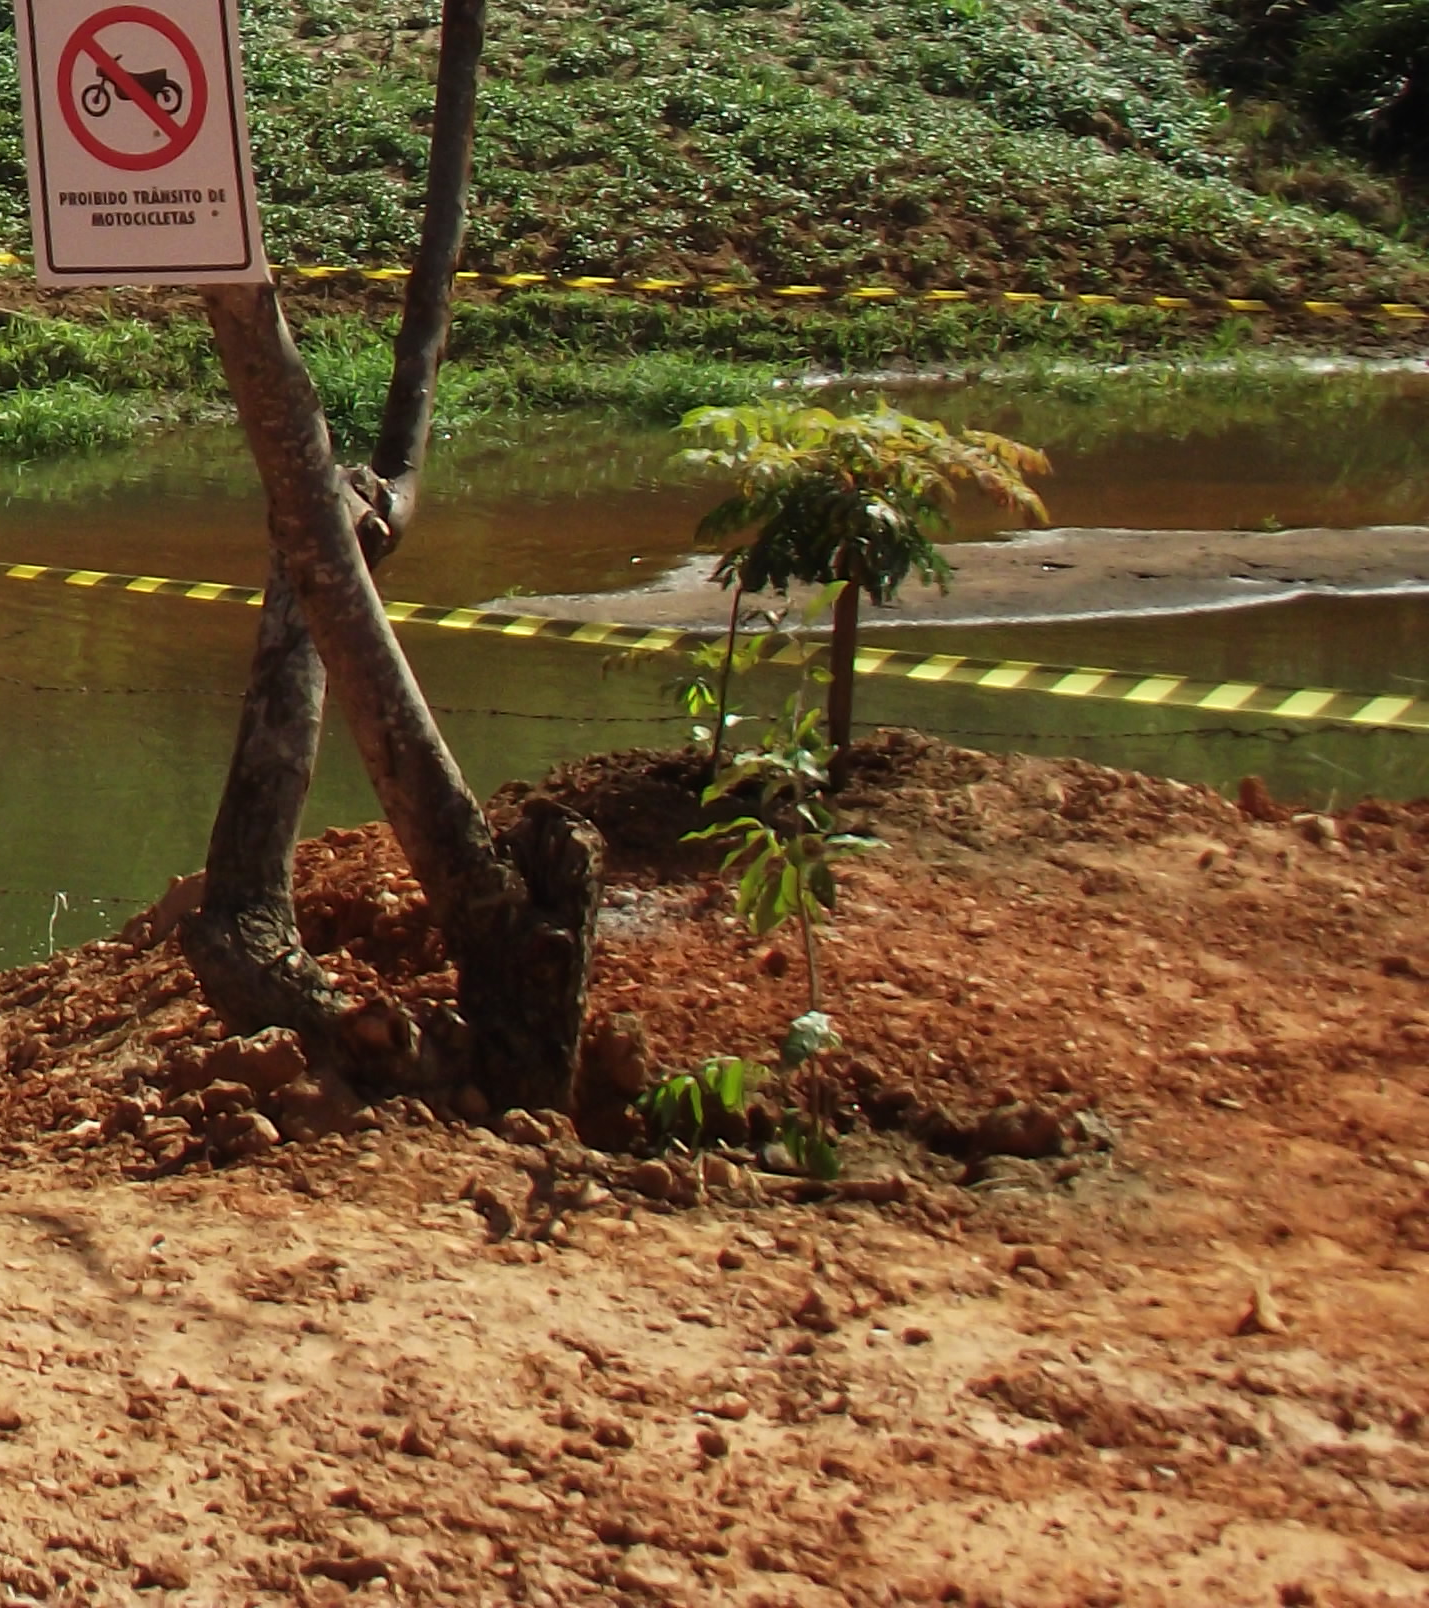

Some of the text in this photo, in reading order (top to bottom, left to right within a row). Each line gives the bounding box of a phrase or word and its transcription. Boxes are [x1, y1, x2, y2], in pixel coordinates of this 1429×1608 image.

[59, 186, 226, 206] PROIBIDO TRÂNSITO DE
[91, 211, 195, 227] MOTOCICLETAS
